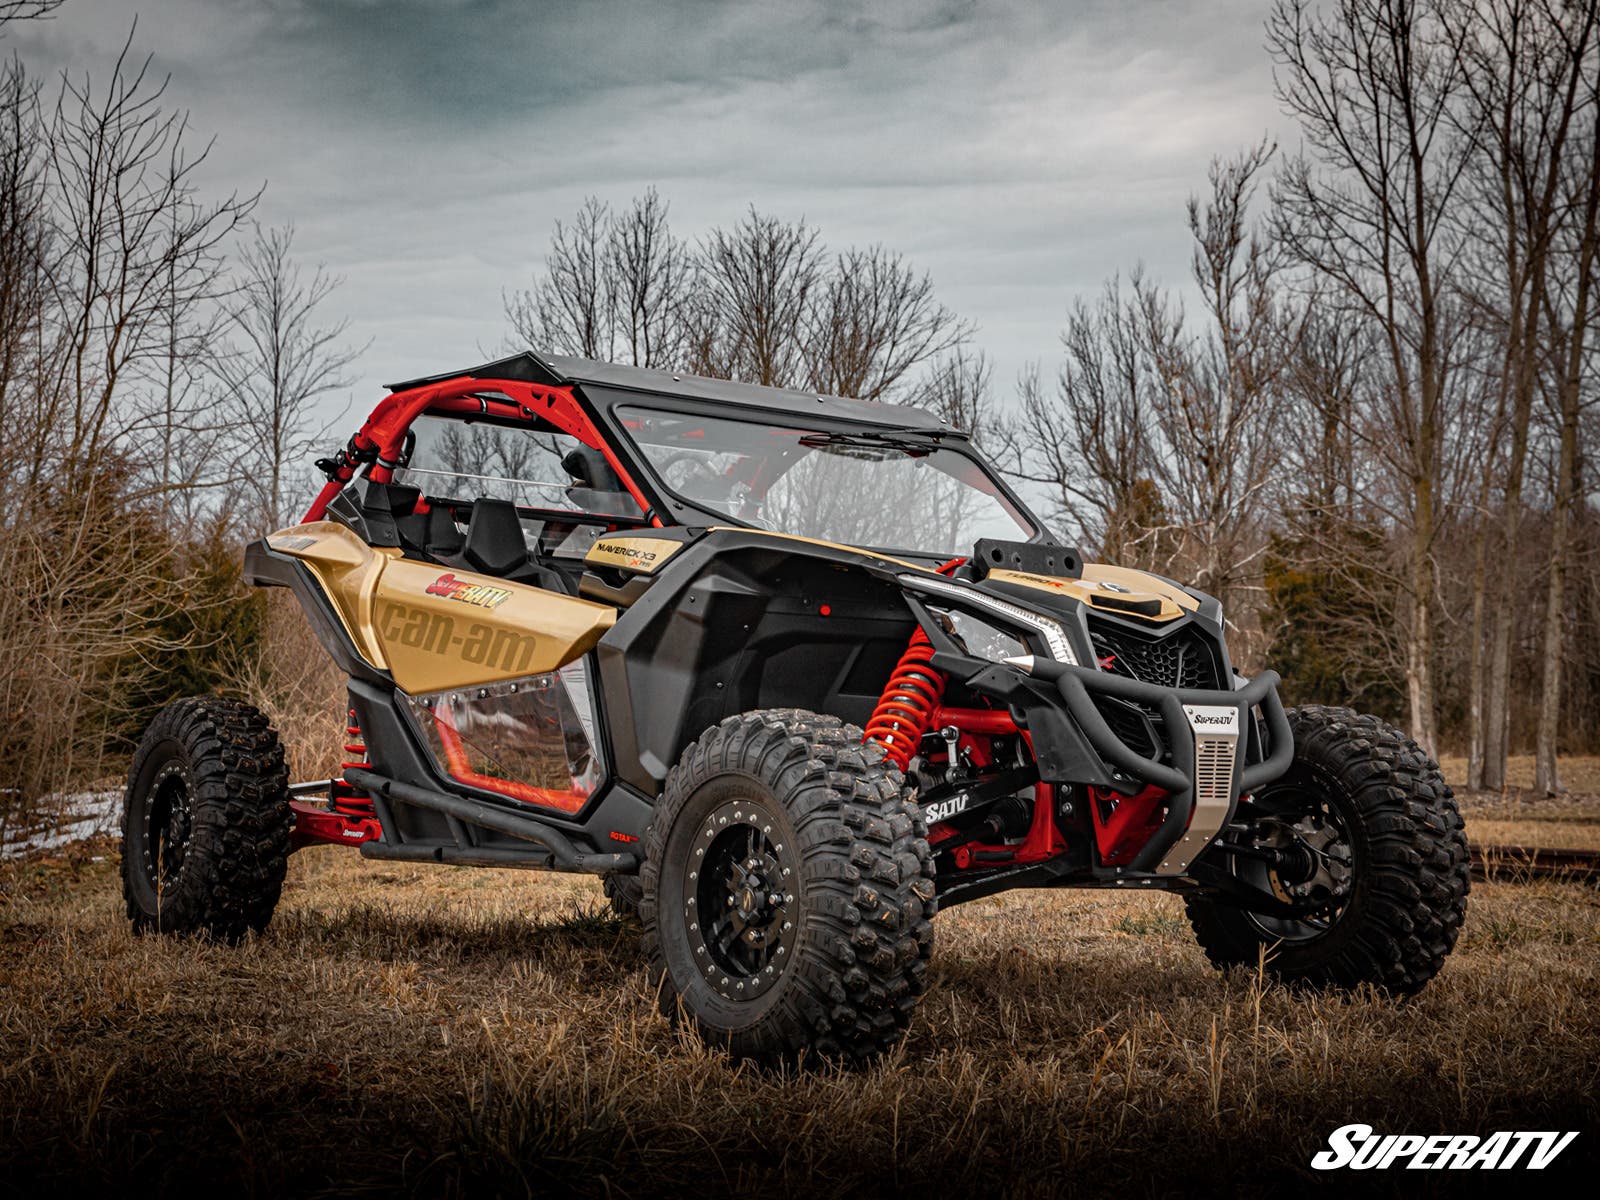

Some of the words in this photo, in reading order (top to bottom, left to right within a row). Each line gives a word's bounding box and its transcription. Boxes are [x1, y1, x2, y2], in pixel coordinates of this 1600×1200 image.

[597, 543, 640, 558] MAVERICK
[641, 551, 656, 561] X3
[380, 603, 536, 672] can-am
[925, 793, 970, 824] SATV
